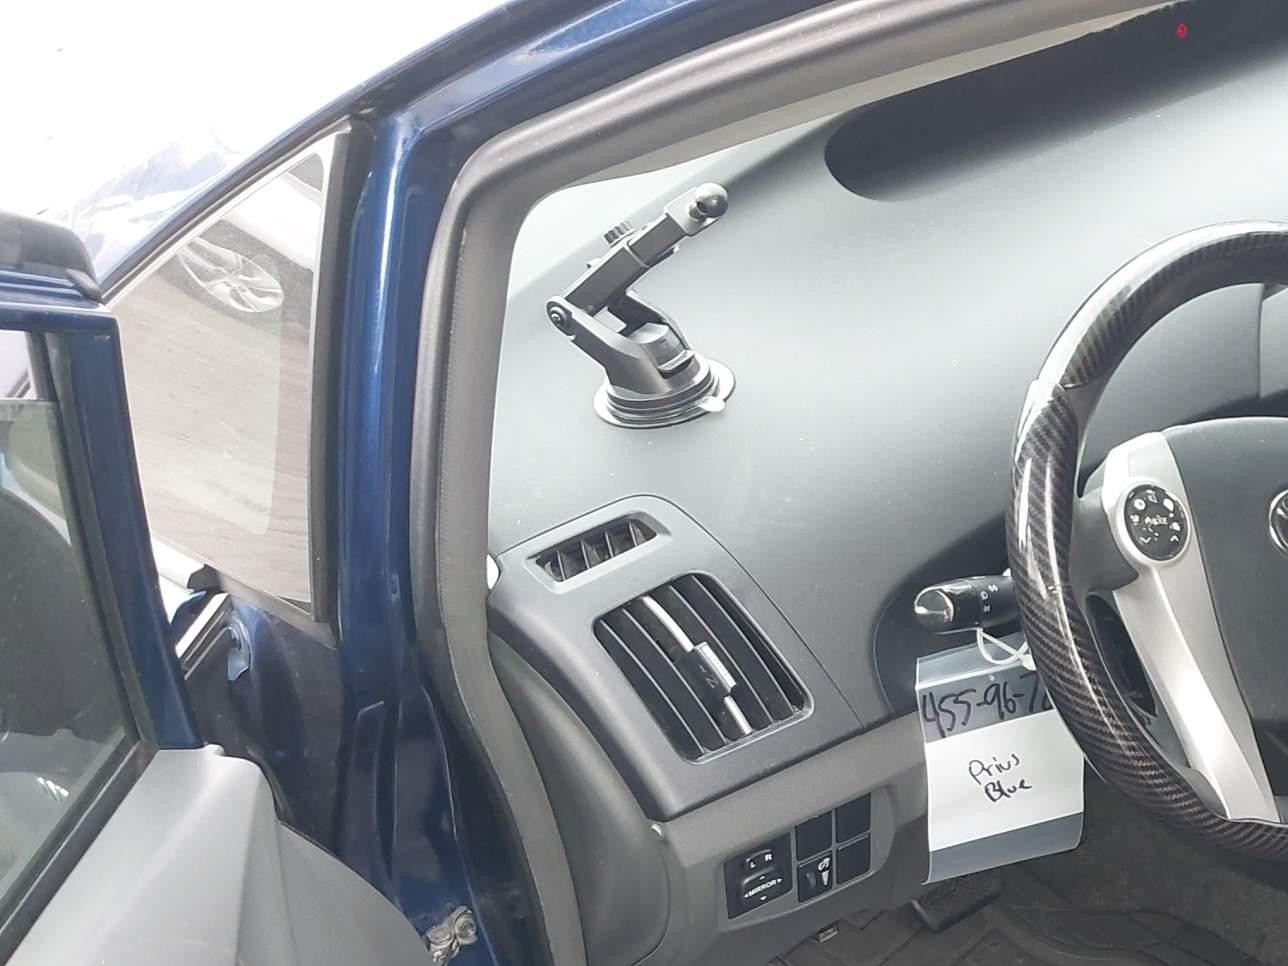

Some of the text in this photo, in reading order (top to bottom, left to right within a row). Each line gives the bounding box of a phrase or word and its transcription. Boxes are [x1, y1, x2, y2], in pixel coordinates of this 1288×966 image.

[922, 671, 1054, 738] 455-96-7
[968, 753, 1020, 786] Prius
[984, 777, 1033, 803] Blue
[764, 852, 773, 862] R
[747, 879, 778, 898] MIRROR
